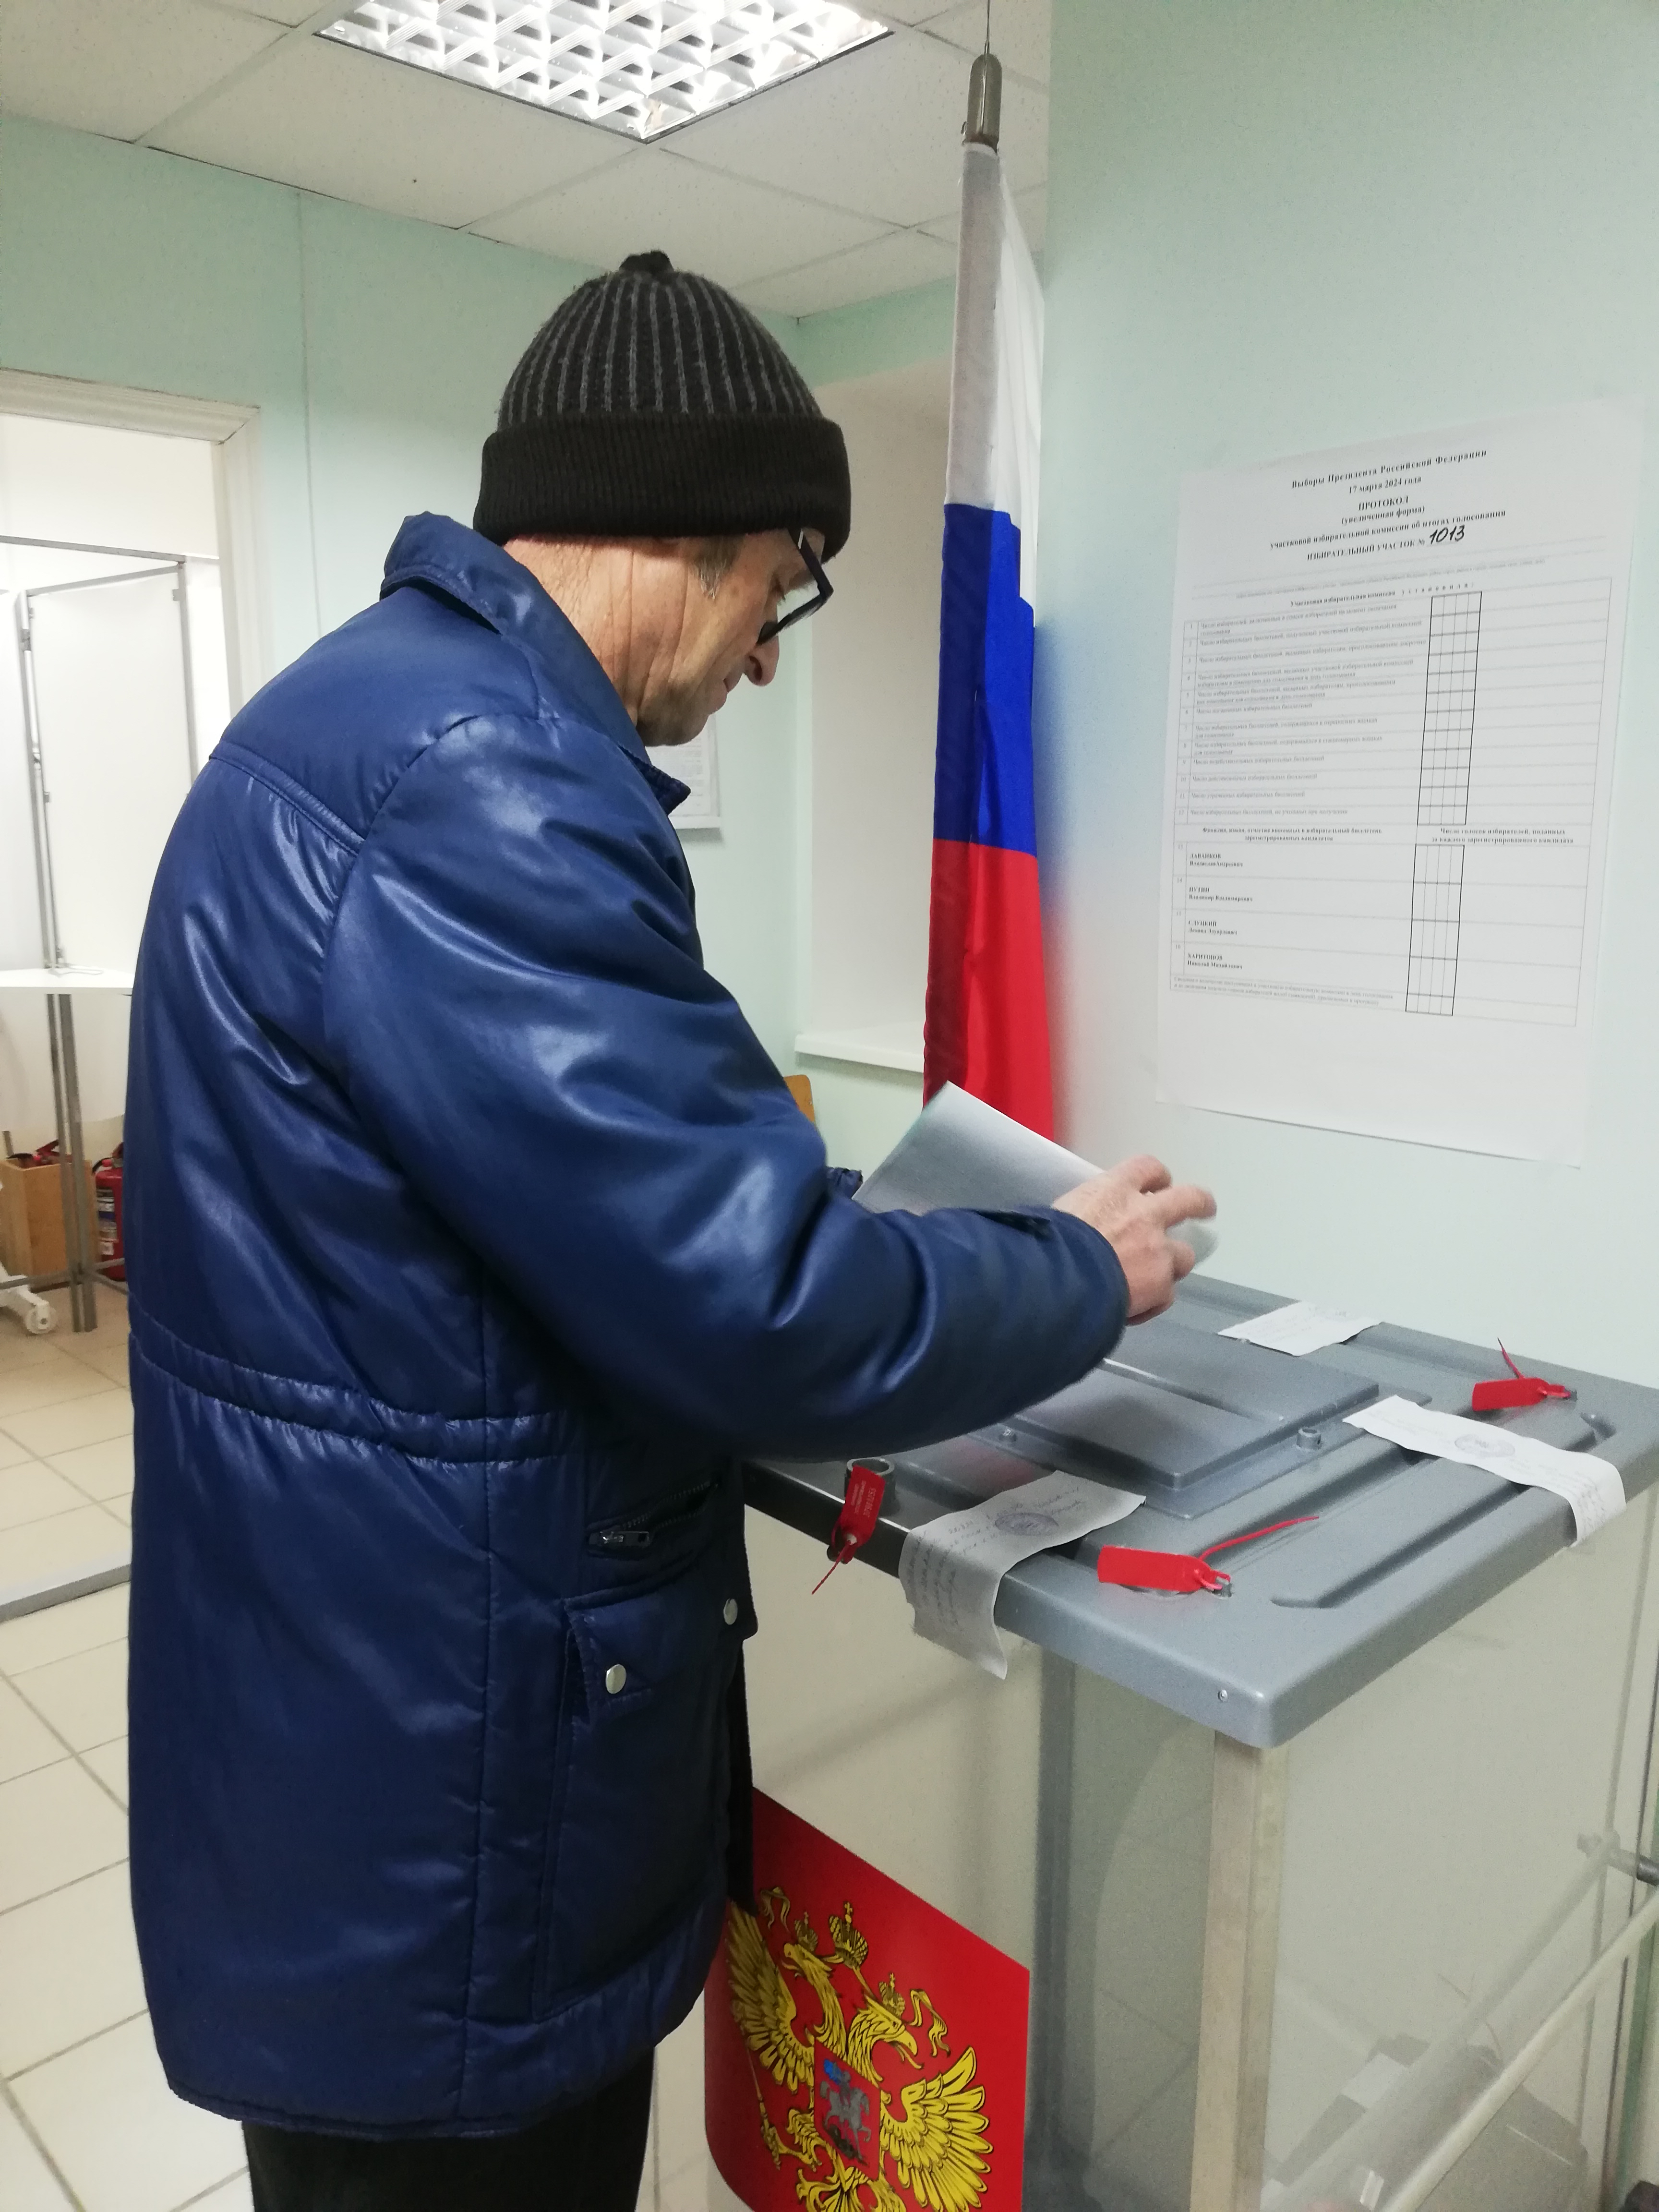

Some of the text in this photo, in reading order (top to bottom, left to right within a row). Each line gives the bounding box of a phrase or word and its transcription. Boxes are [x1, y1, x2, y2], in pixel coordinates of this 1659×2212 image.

[1292, 450, 1487, 489] Выборы Президента Российской Федерации
[1349, 476, 1421, 493] 17 марта 2024 года
[1358, 495, 1409, 511] ПРОТОКОЛ
[1396, 505, 1425, 518] форма)
[1313, 528, 1369, 542] избирательной
[1371, 524, 1409, 535] комиссии
[1411, 520, 1420, 529] об
[1422, 517, 1450, 528] итогах
[1452, 510, 1506, 524] голосования
[1429, 524, 1465, 545] 1013
[1307, 543, 1375, 561] ИЗБИРАТЕЛЬНЫЙ
[1377, 540, 1415, 552] УЧАСТОК
